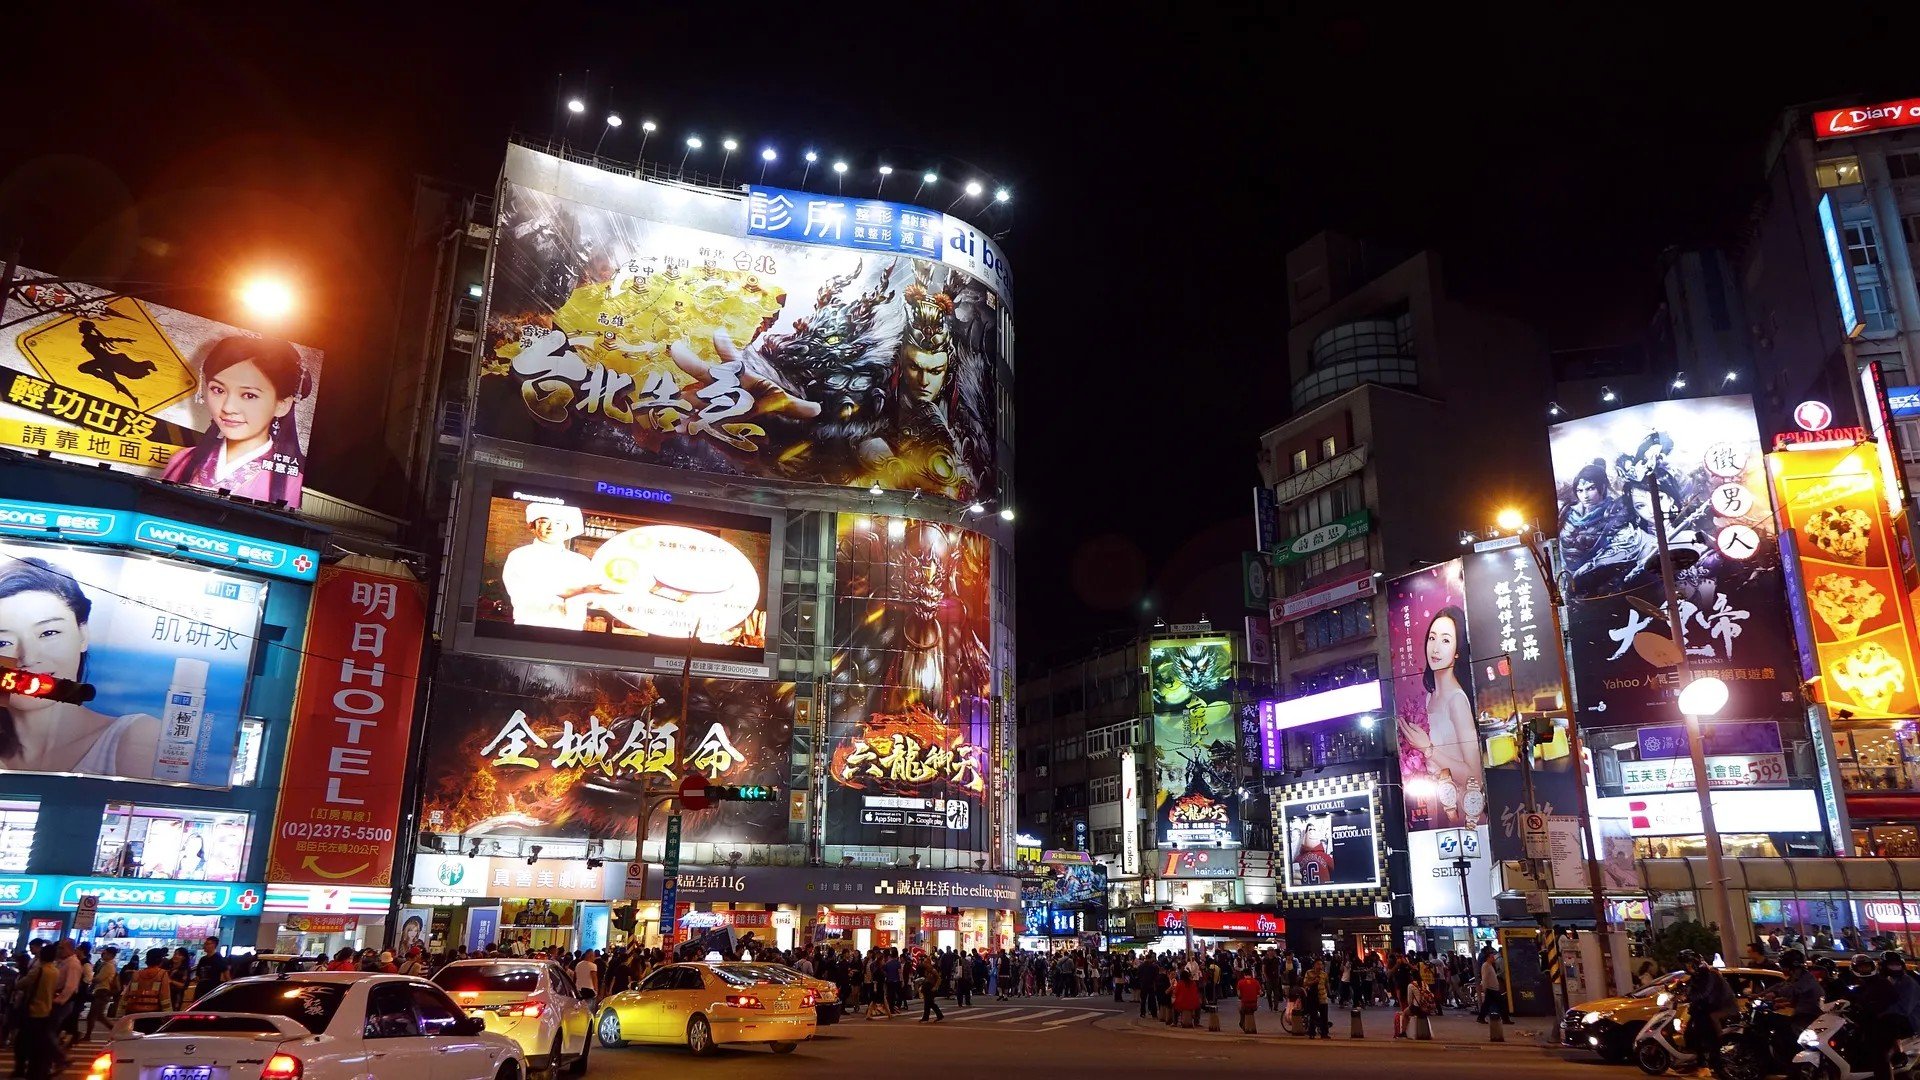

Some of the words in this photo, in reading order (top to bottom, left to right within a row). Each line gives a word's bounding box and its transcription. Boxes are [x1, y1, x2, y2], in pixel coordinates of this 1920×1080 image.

[1849, 105, 1902, 123] Diary
[750, 192, 845, 240] 診所
[628, 258, 654, 276] 台中
[733, 250, 777, 276] 台北
[597, 312, 624, 327] 高雄
[8, 375, 157, 440] 輕功出沒
[22, 425, 172, 463] 請靠地面走
[1816, 427, 1867, 442] STONE
[262, 460, 299, 477] 陳意涵
[597, 481, 673, 503] Panasonic
[149, 527, 230, 553] watsons
[151, 615, 240, 651] 肌研水
[325, 580, 398, 804] 明日HOTEL
[1602, 678, 1640, 691] Yahoo
[174, 711, 191, 737] 極潤
[480, 708, 748, 782] 全城領命
[1627, 768, 1667, 783] 玉芙蓉
[875, 816, 887, 824] App
[282, 822, 392, 842] (02)2375-5500
[493, 868, 597, 889] 真善美劇院
[75, 886, 165, 903] watsons
[896, 880, 950, 897] 誠品生活
[951, 880, 969, 897] the
[969, 882, 993, 898] eslite
